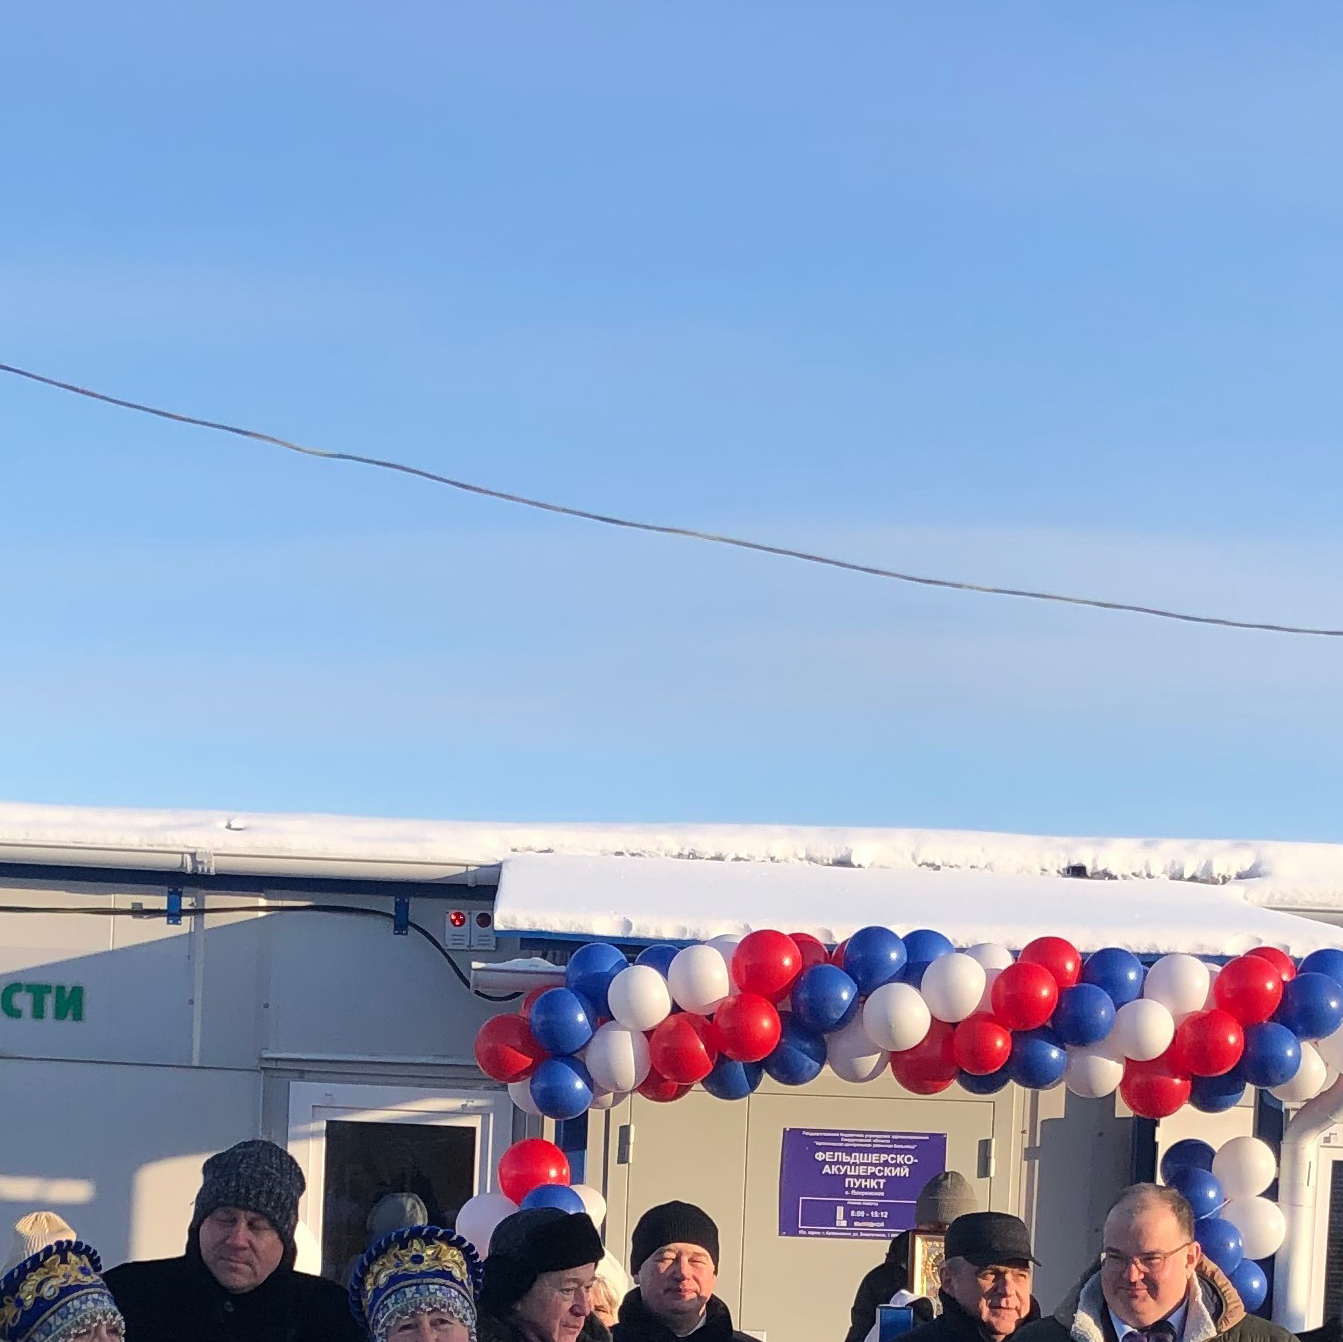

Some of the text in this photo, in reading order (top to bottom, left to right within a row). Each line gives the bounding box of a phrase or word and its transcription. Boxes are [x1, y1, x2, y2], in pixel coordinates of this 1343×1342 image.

[814, 1151, 919, 1166] ФЕЛЬДШЕРСКО-
[821, 1164, 910, 1178] АКУШЕРСКИЙ
[844, 1178, 887, 1190] ПУНКТ
